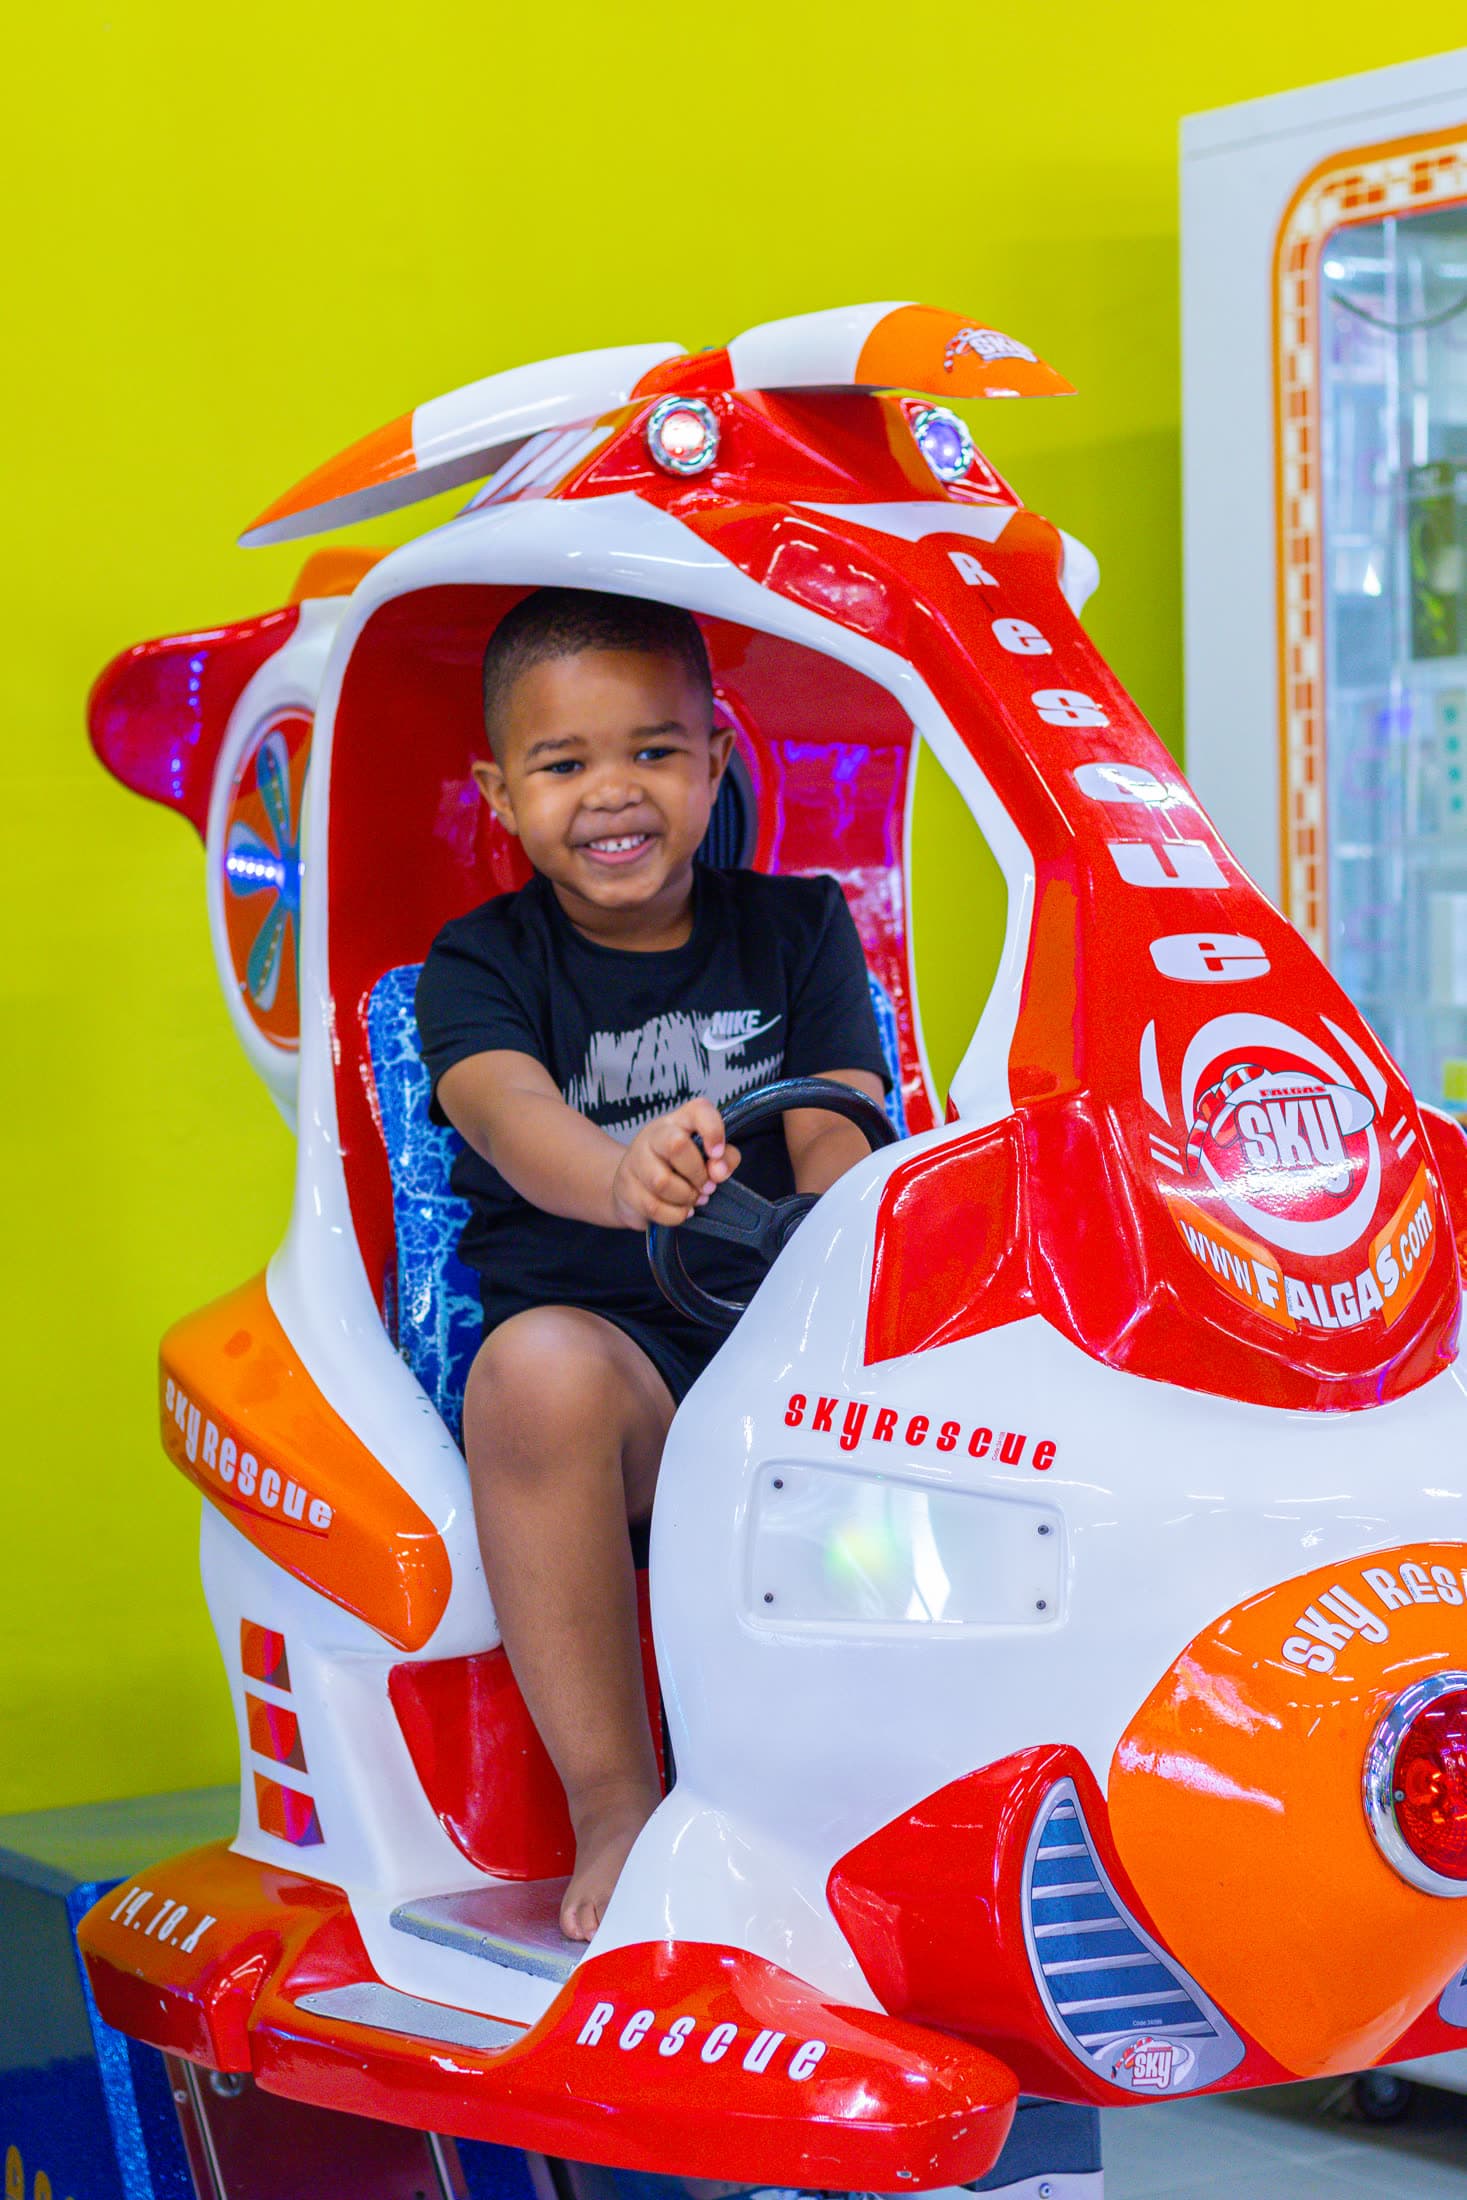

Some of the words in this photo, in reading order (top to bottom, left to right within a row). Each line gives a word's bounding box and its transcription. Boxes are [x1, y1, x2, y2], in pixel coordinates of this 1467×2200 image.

[712, 1010, 761, 1035] NIKE
[1259, 1085, 1326, 1098] FALGAS
[1282, 1584, 1390, 1674] SKY
[1360, 1562, 1467, 1611] RES
[1134, 2051, 1171, 2087] SKY
